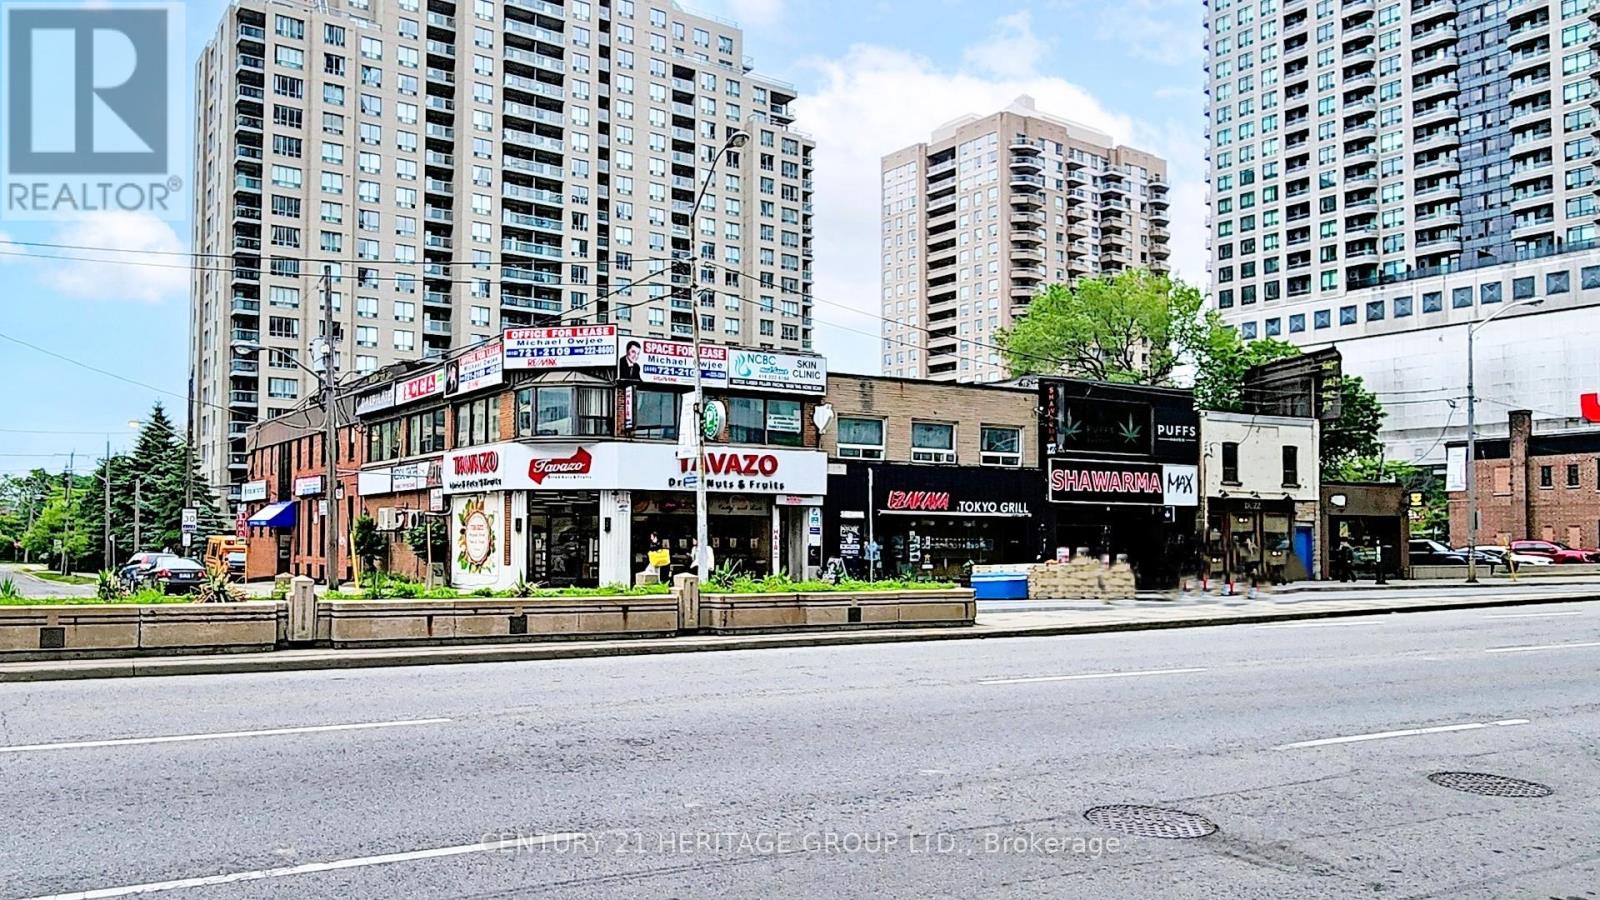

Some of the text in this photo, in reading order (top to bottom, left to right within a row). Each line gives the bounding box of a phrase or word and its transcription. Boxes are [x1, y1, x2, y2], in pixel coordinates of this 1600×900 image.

[512, 327, 609, 339] OFFICE FOR LEASE
[517, 338, 561, 346] Michael
[645, 342, 724, 359] SPACE FOR EASE
[648, 355, 687, 365] Michael
[748, 353, 776, 366] NCBC
[797, 360, 817, 369] SKIN
[792, 370, 821, 379] CLINIC
[1157, 424, 1196, 437] PUFFS
[452, 450, 499, 476] TAVAZO
[533, 459, 585, 473] Tavazo
[706, 479, 734, 489] Nuts
[738, 479, 745, 490] &
[749, 478, 785, 490] Fruits
[1051, 468, 1162, 493] SHAWARMA
[1167, 472, 1194, 495] MAX
[959, 500, 1029, 514] TOKYO GRILL
